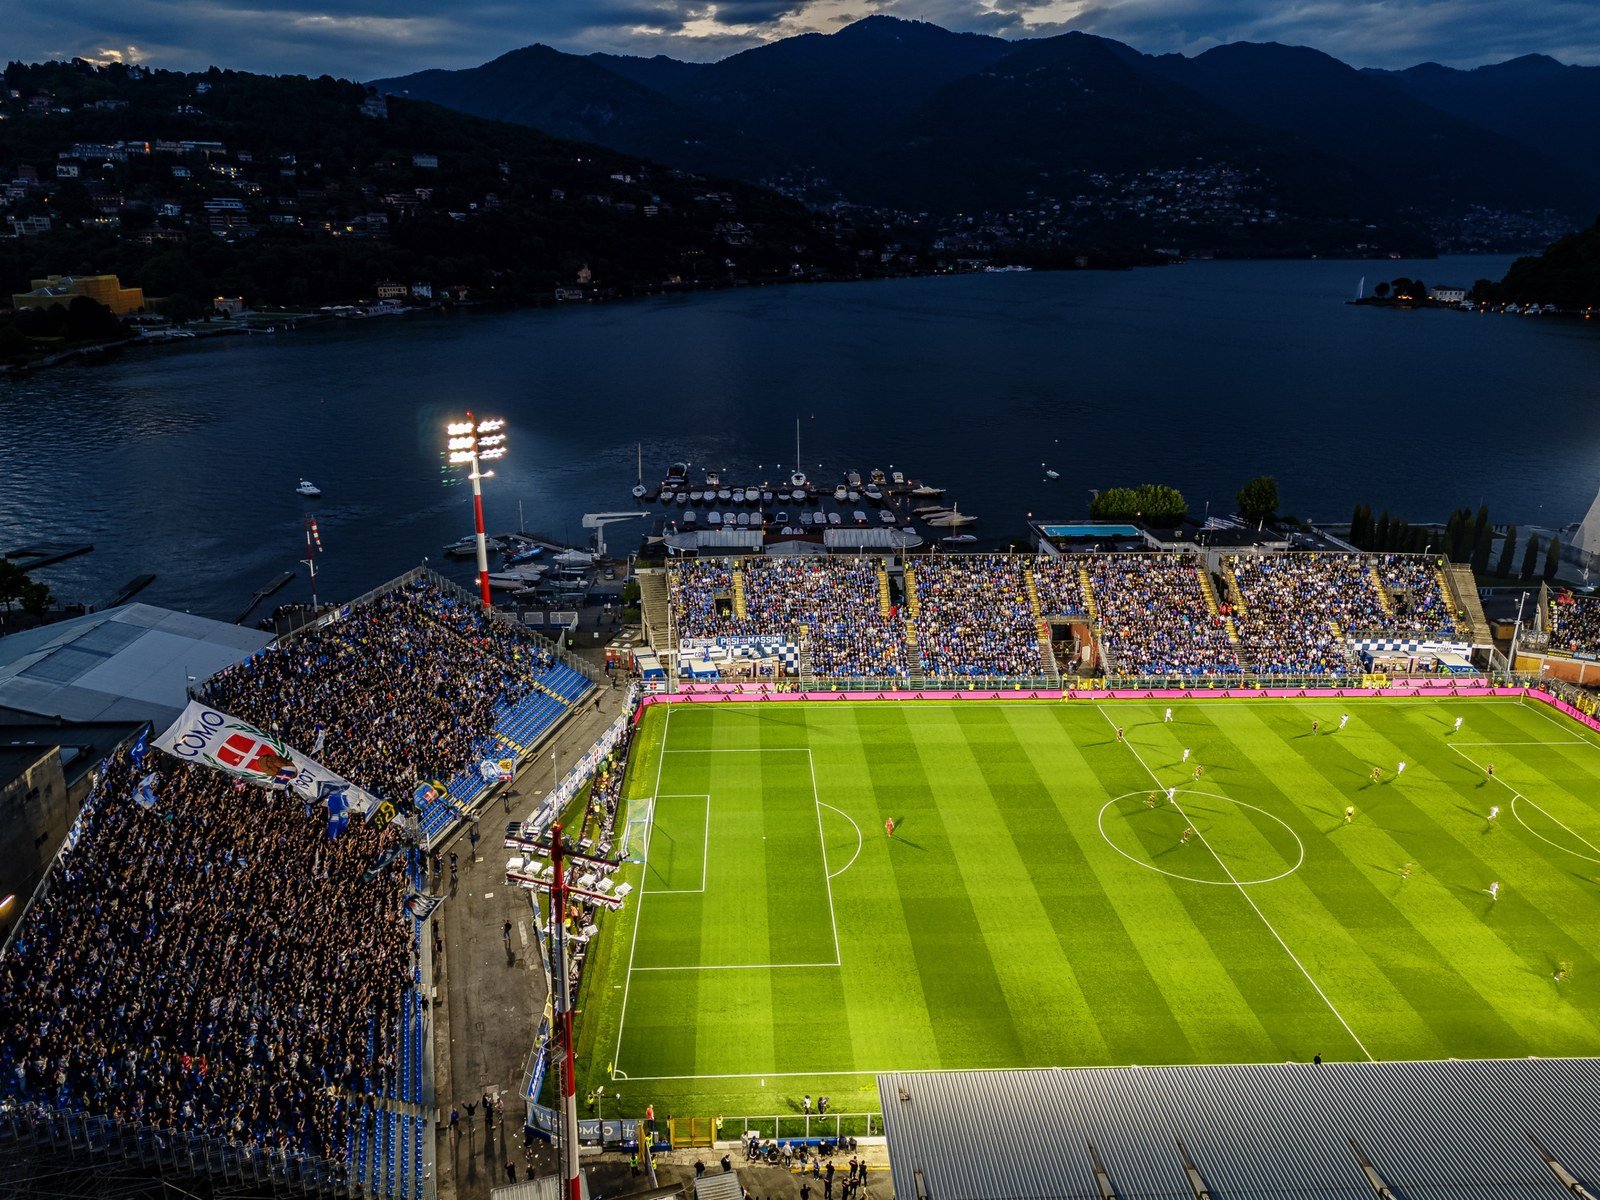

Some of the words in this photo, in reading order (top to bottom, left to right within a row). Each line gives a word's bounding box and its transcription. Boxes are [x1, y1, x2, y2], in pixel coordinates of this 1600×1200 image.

[748, 636, 783, 644] MASSIMI
[172, 711, 225, 757] COMO
[294, 768, 317, 790] 1907
